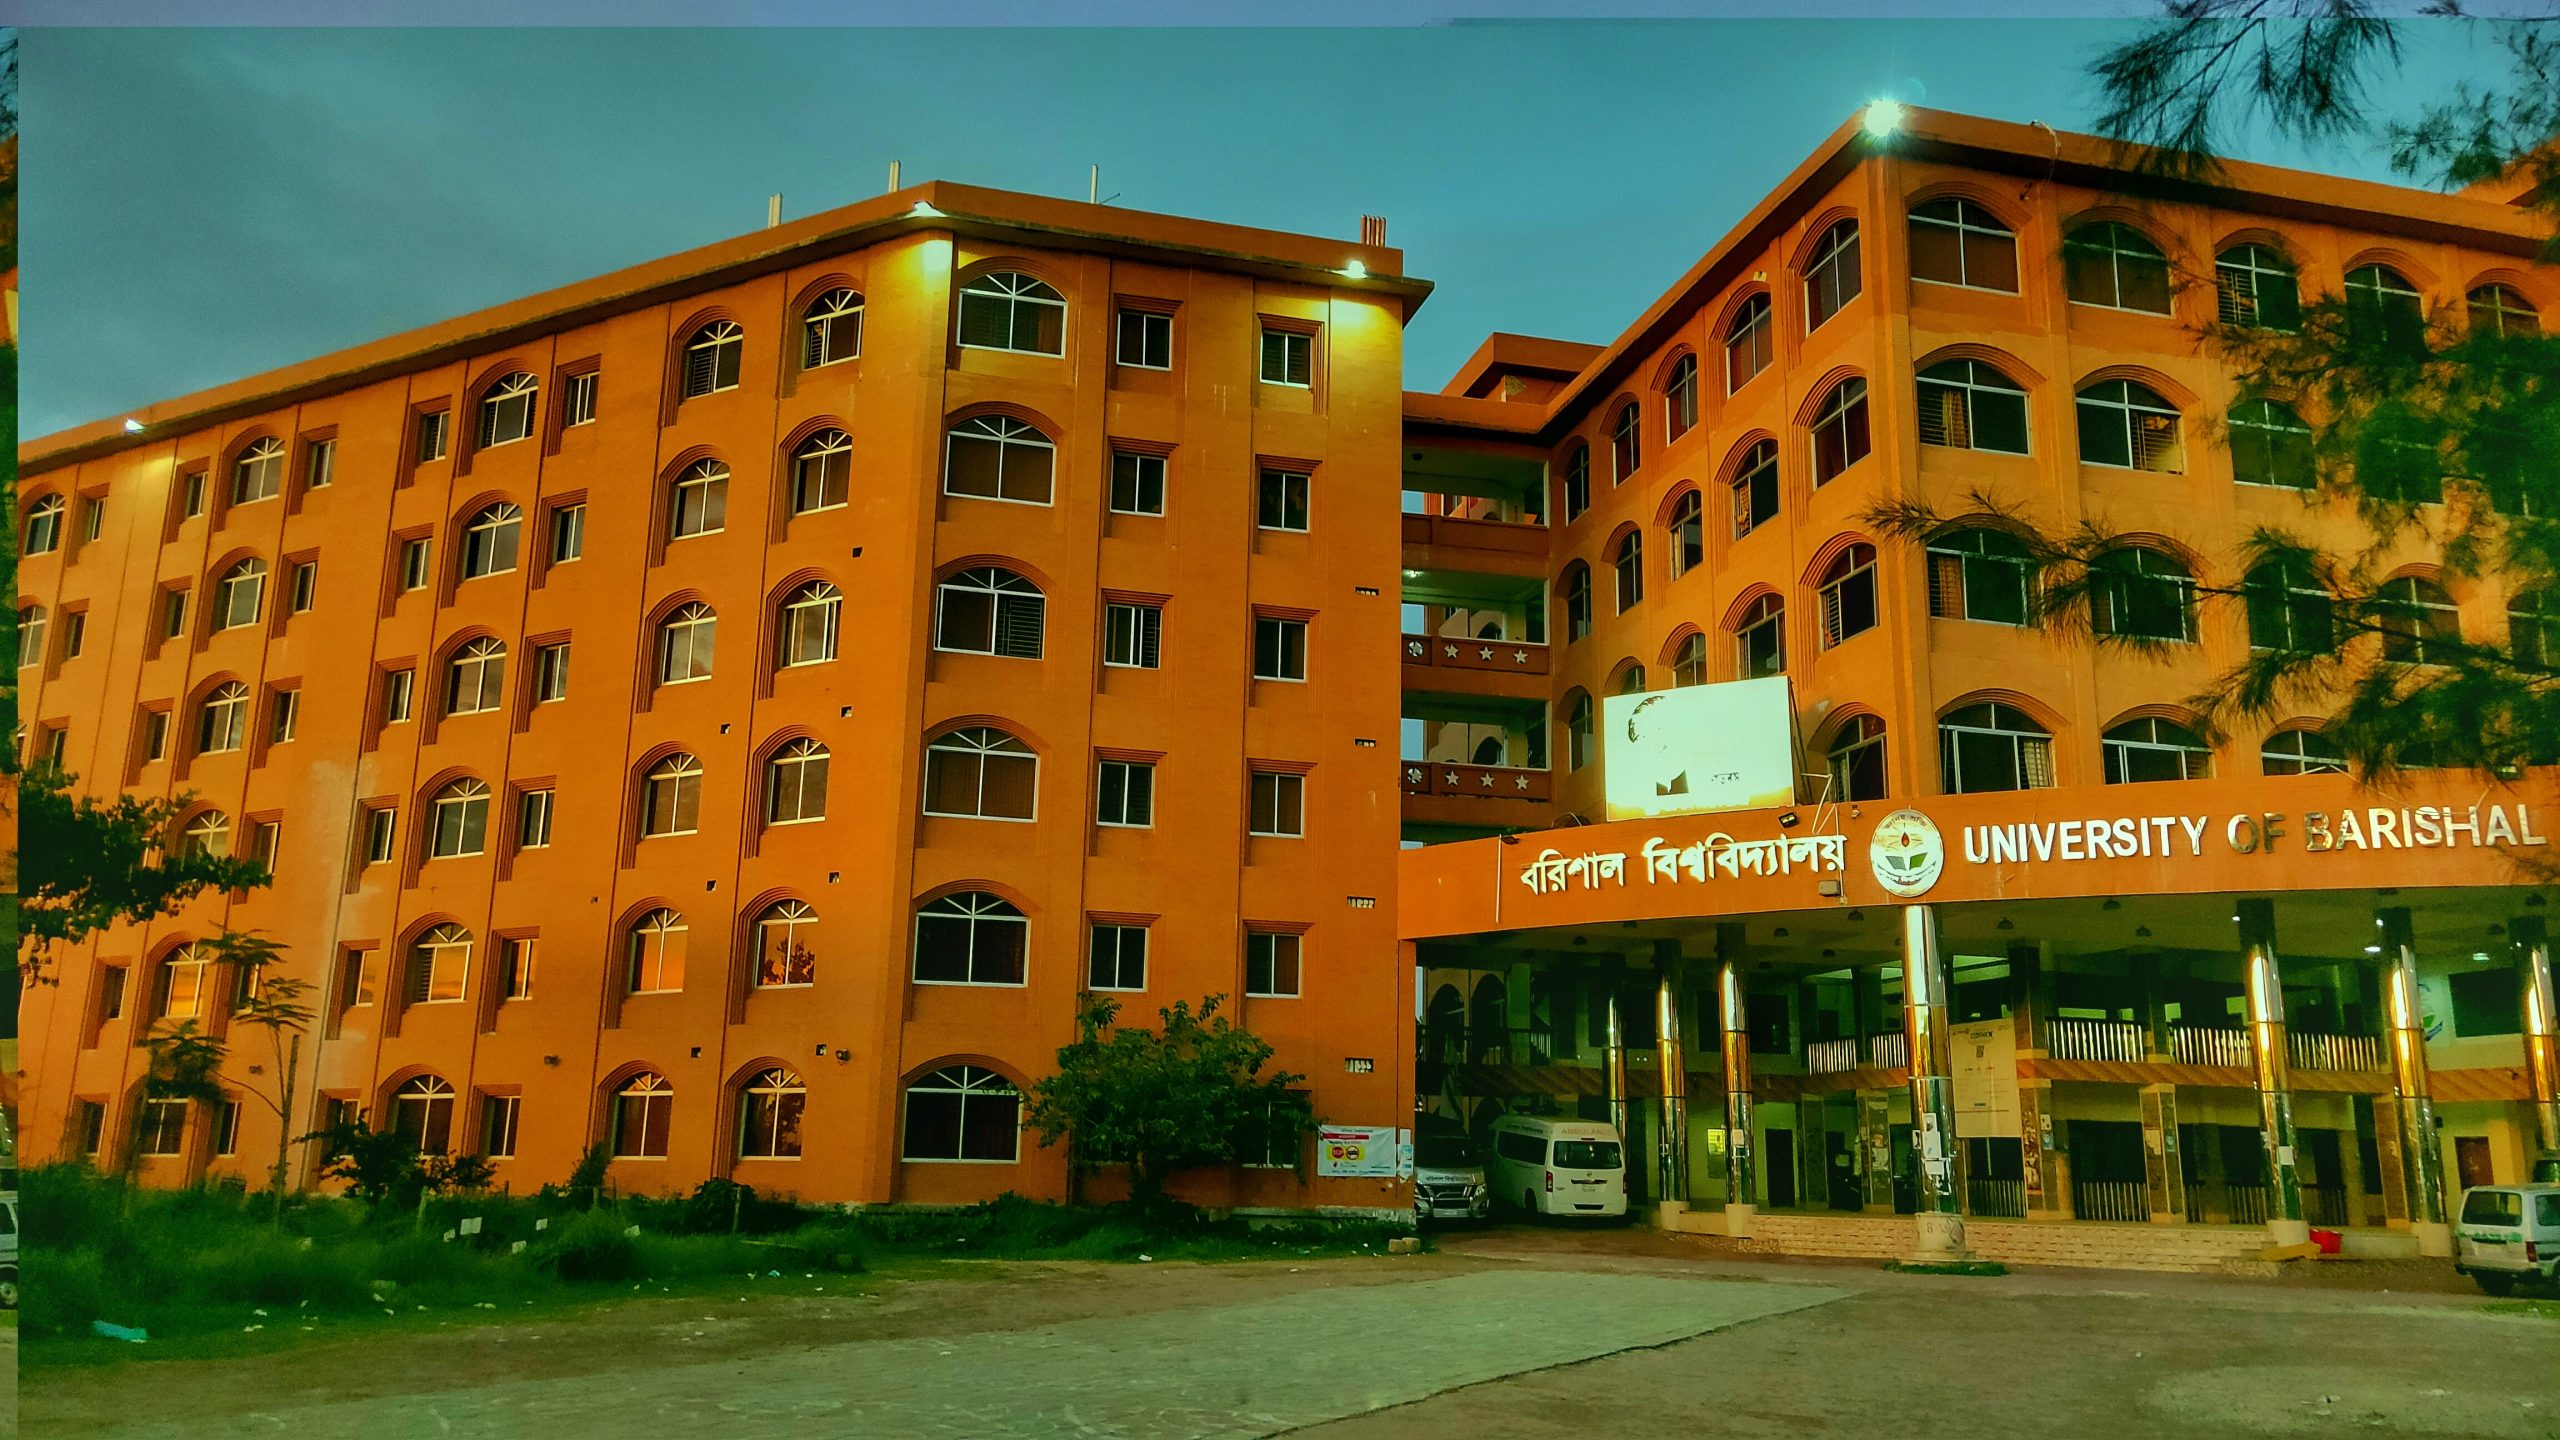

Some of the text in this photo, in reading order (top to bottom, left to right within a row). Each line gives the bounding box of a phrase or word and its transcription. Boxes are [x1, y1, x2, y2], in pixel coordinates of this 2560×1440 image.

[1963, 804, 2548, 863] UNIVERSITY OF BARISHAL
[1520, 833, 1848, 895] বরিশাল বিশ্ববিদ্যালয়
